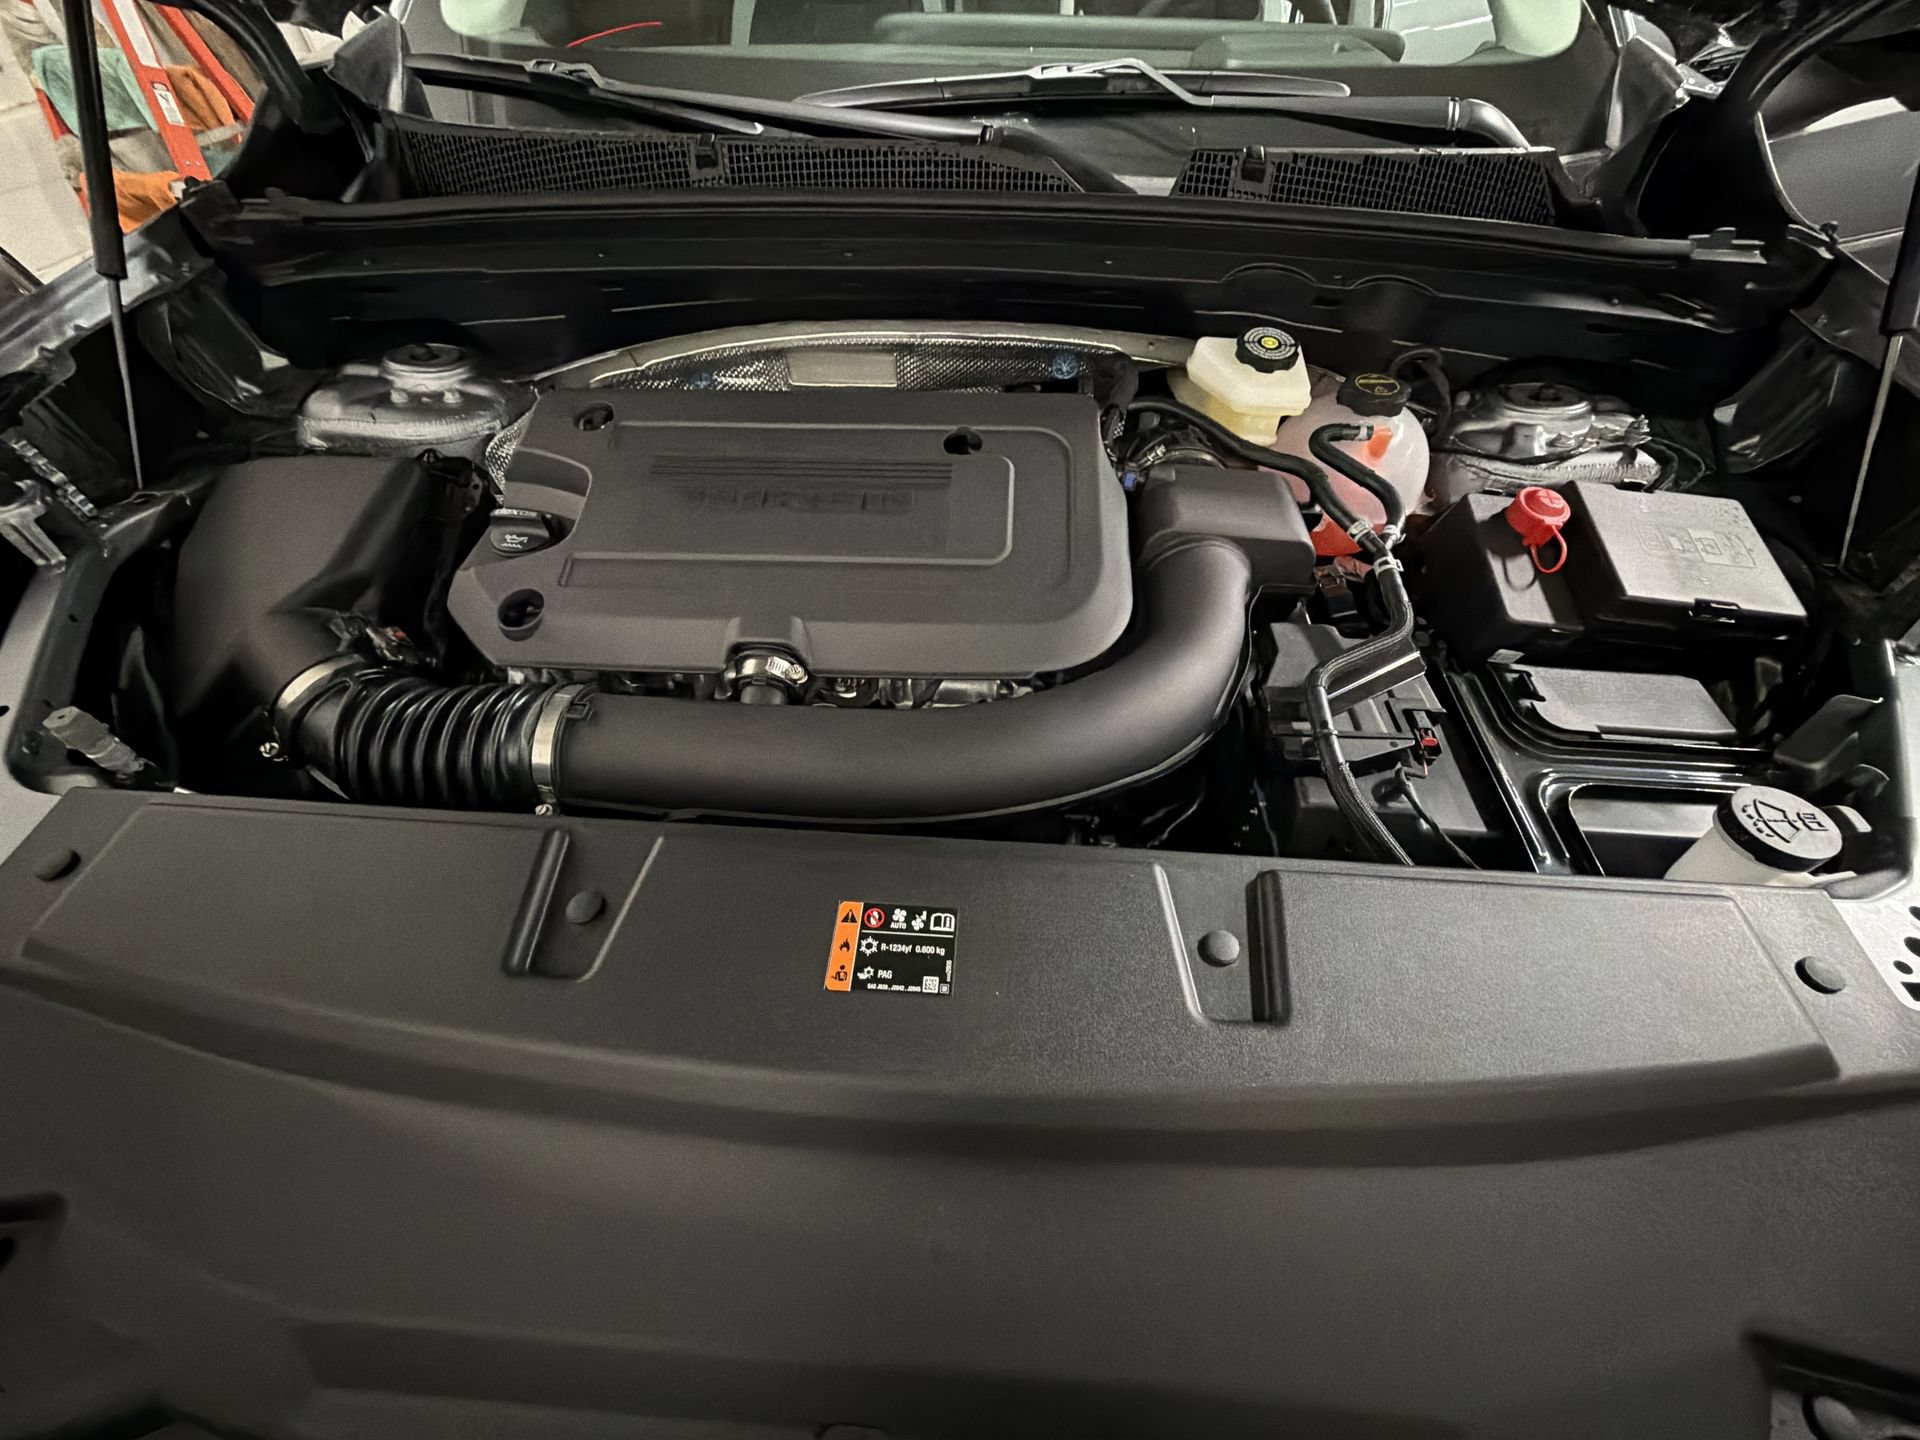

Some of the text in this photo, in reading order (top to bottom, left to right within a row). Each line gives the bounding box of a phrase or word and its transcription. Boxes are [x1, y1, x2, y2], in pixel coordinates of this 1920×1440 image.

[890, 922, 907, 930] AUTO
[881, 943, 912, 953] R-1234yf
[936, 946, 945, 956] kg
[877, 969, 893, 979] PAG
